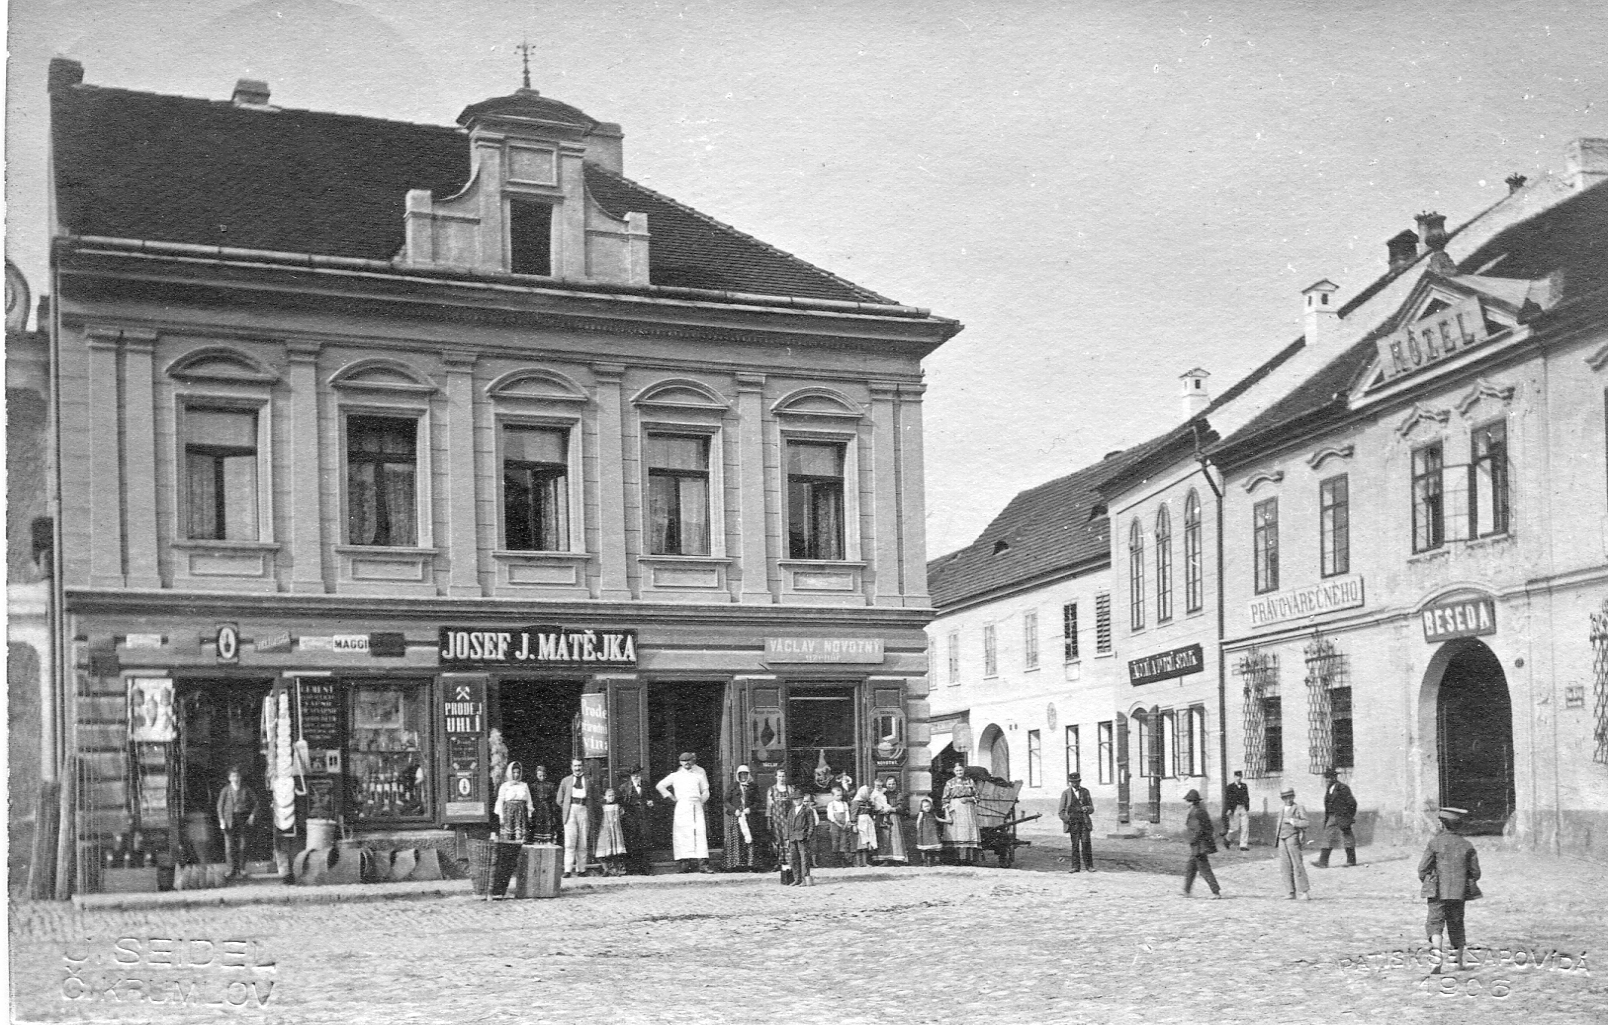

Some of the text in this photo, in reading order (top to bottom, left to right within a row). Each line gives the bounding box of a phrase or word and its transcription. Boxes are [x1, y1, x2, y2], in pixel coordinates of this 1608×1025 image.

[1423, 601, 1490, 636] BESEDA
[334, 640, 368, 649] MAGGI
[442, 630, 637, 661] JOSEF J. MATĚJKA
[770, 638, 879, 653] VÁCLAV NOVOTNÝ
[445, 702, 482, 716] PRODEJ
[446, 714, 480, 732] UHLÍ
